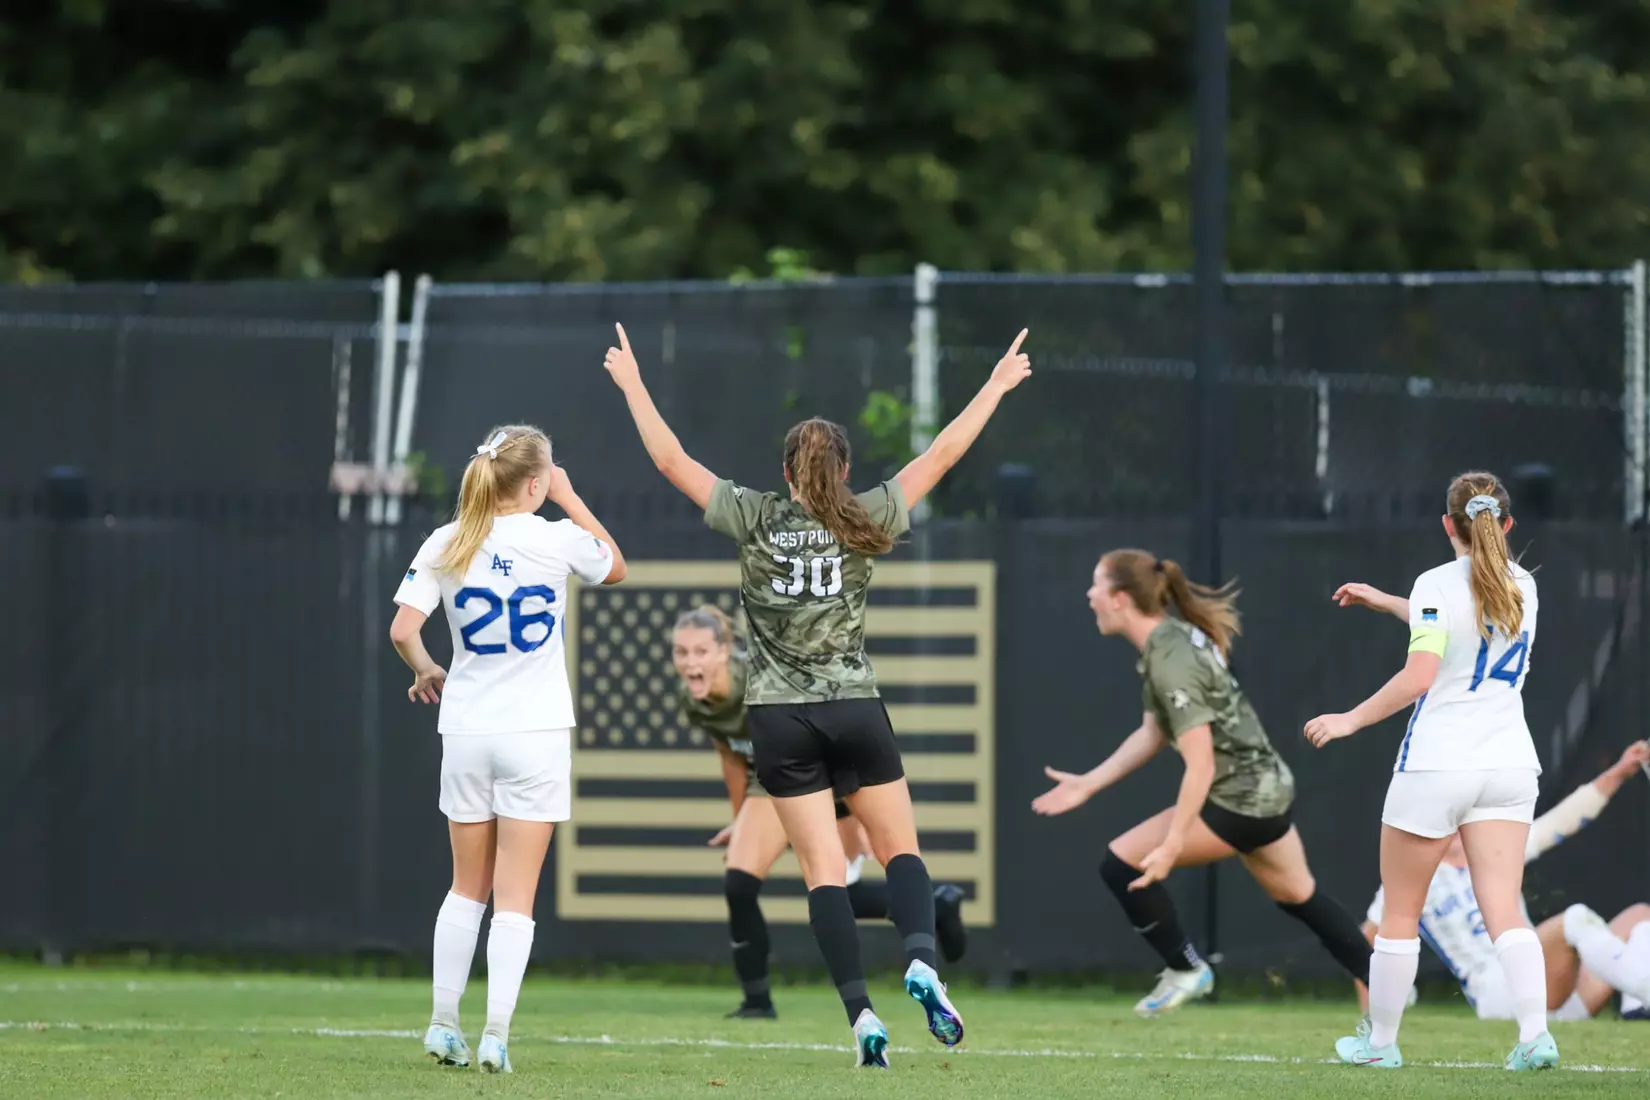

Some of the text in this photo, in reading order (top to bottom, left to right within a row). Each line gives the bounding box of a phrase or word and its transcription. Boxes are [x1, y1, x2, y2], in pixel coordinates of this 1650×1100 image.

[769, 529, 834, 547] WEST POI
[491, 553, 513, 576] AF
[771, 554, 843, 597] 30
[454, 584, 556, 655] 26
[1467, 625, 1529, 692] 14
